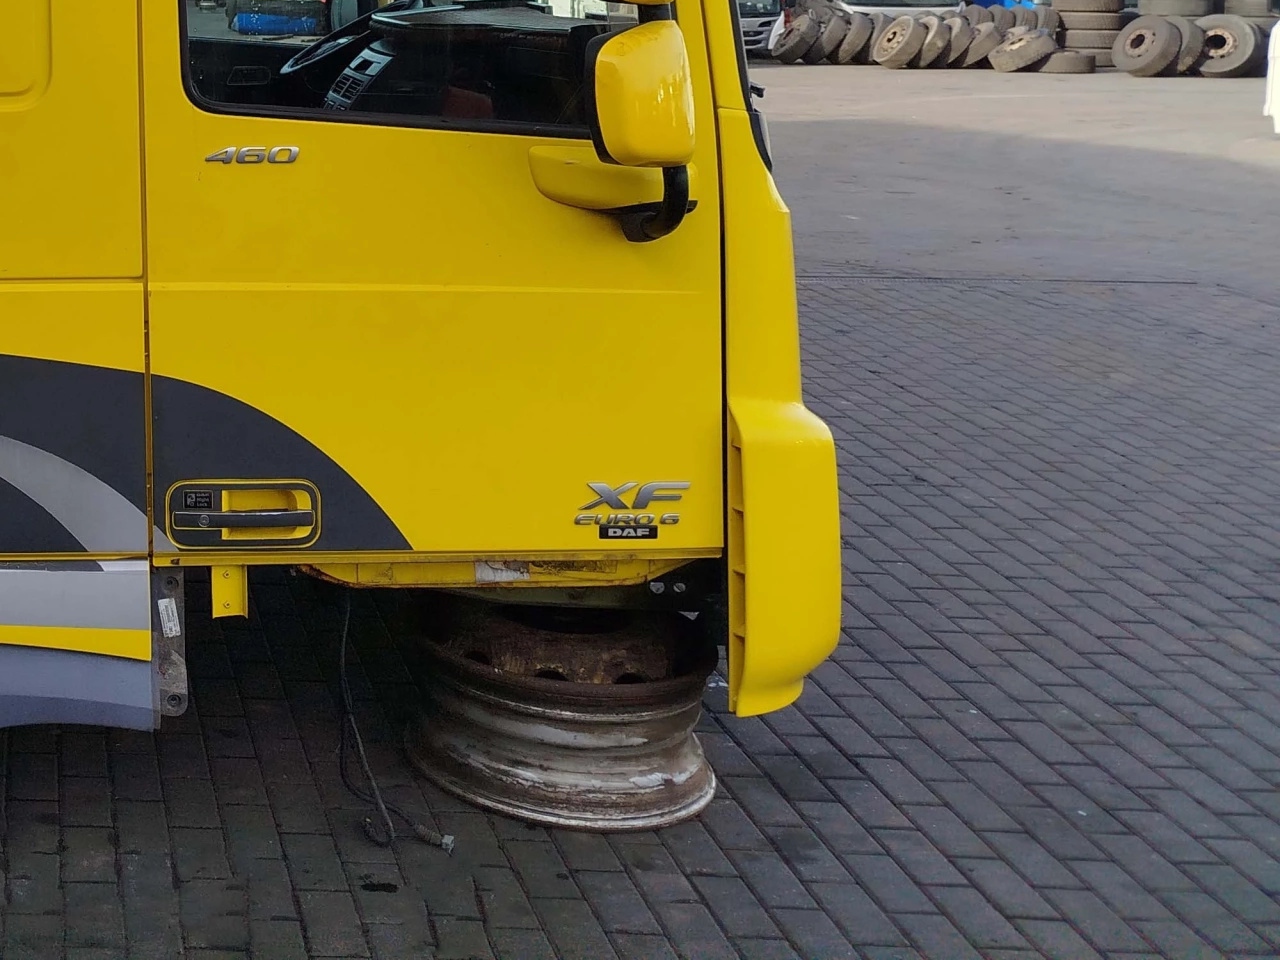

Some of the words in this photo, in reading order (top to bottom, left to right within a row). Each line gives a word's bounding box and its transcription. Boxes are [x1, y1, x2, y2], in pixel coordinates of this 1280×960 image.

[204, 146, 300, 164] 460
[578, 481, 691, 510] XF
[574, 513, 655, 526] EURO
[659, 513, 681, 525] 6
[607, 527, 650, 538] DAF
